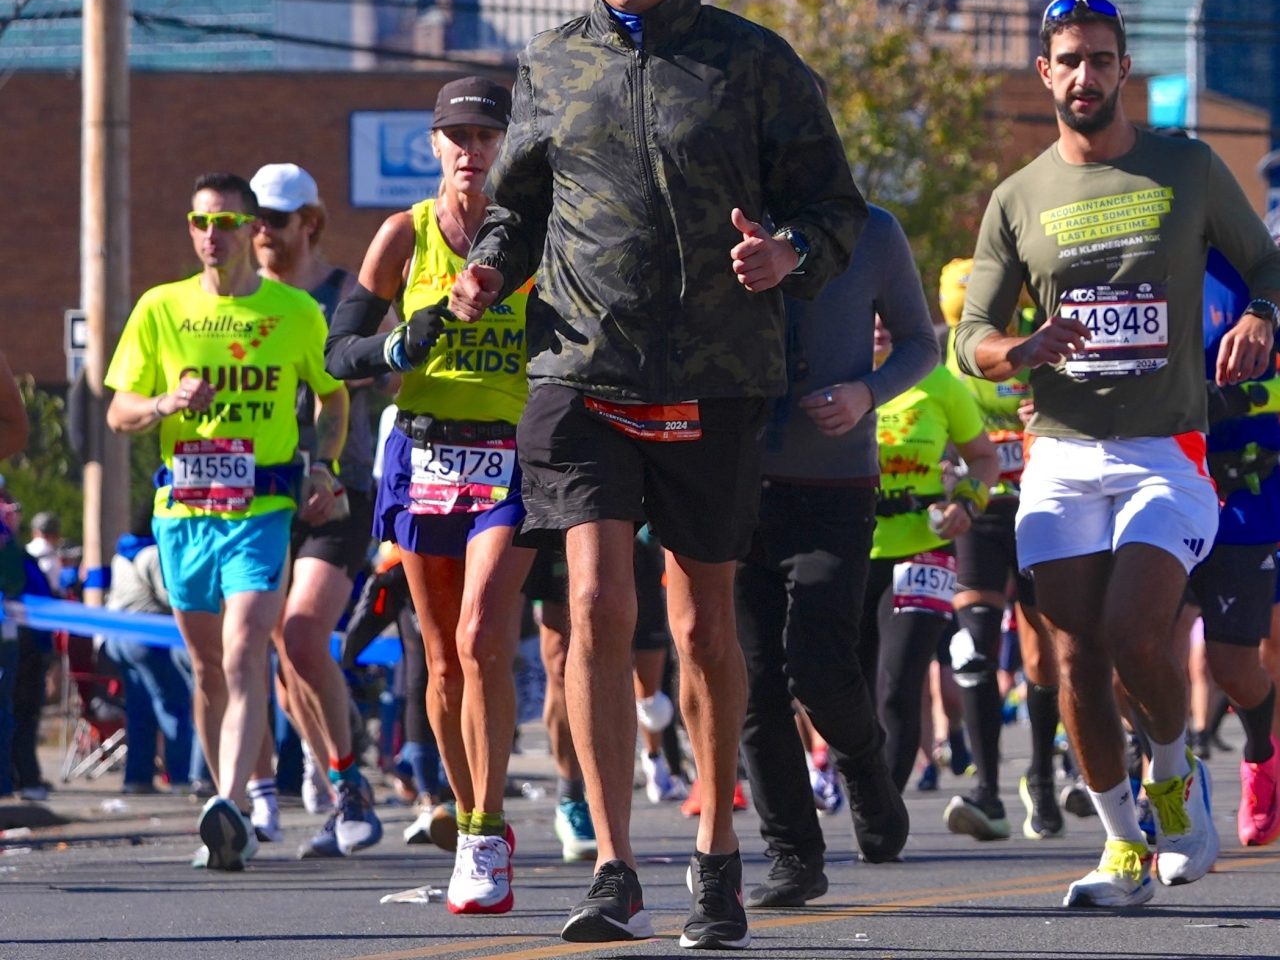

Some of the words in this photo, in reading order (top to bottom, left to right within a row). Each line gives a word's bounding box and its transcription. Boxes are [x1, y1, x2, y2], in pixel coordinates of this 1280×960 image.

[1136, 189, 1168, 201] MADE
[1051, 221, 1063, 232] AT
[1066, 215, 1099, 228] RACES
[1102, 204, 1165, 221] SOMETIMES
[1060, 230, 1086, 243] LAST
[1089, 227, 1097, 237] A
[1058, 246, 1078, 259] JOE
[1079, 235, 1143, 256] KLEINERMAN
[179, 316, 254, 333] Achilles
[445, 327, 524, 351] TEAM
[455, 349, 521, 375] KIDS
[1136, 359, 1158, 368] 2024
[665, 421, 688, 430] 2024
[181, 456, 248, 479] 14556
[424, 447, 504, 478] 25178
